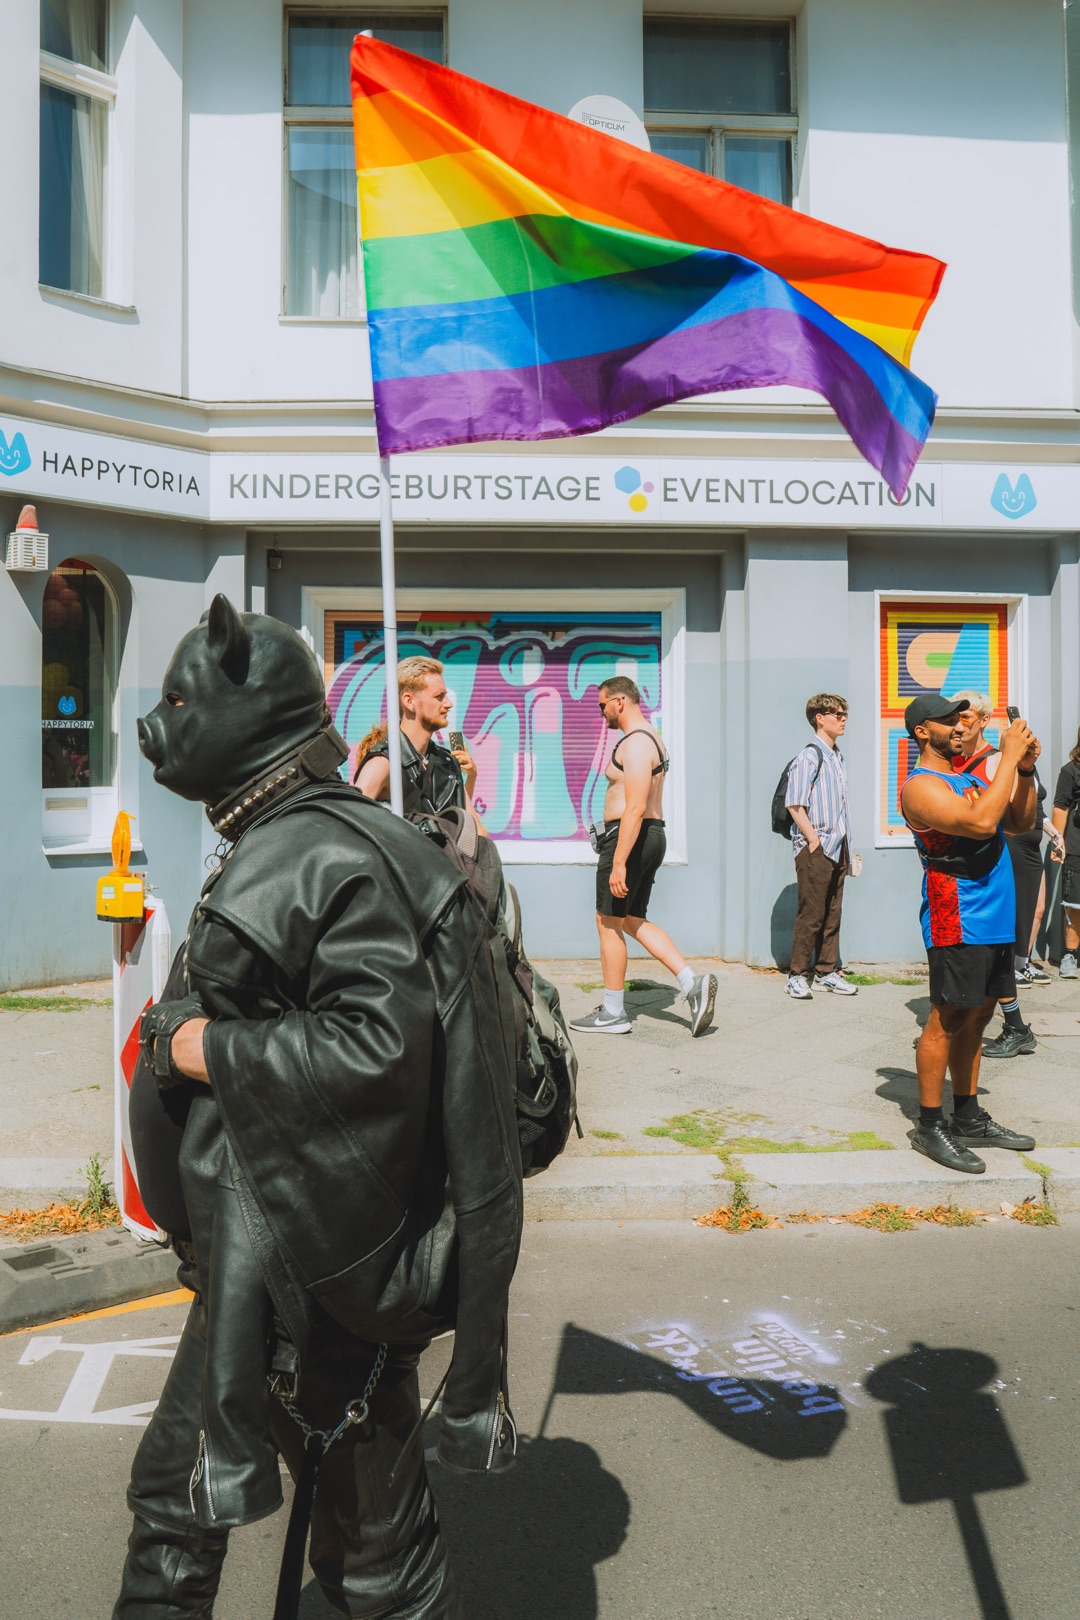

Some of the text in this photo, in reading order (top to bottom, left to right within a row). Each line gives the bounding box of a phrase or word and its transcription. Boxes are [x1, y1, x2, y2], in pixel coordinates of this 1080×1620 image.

[588, 118, 625, 131] OPTICUM
[42, 450, 201, 497] HAPPYTORIA
[229, 473, 936, 508] KINDERGEBURTSTAGE EVENTLOCATION
[41, 720, 94, 729] HAPPYTORIA
[731, 1338, 846, 1417] berlin
